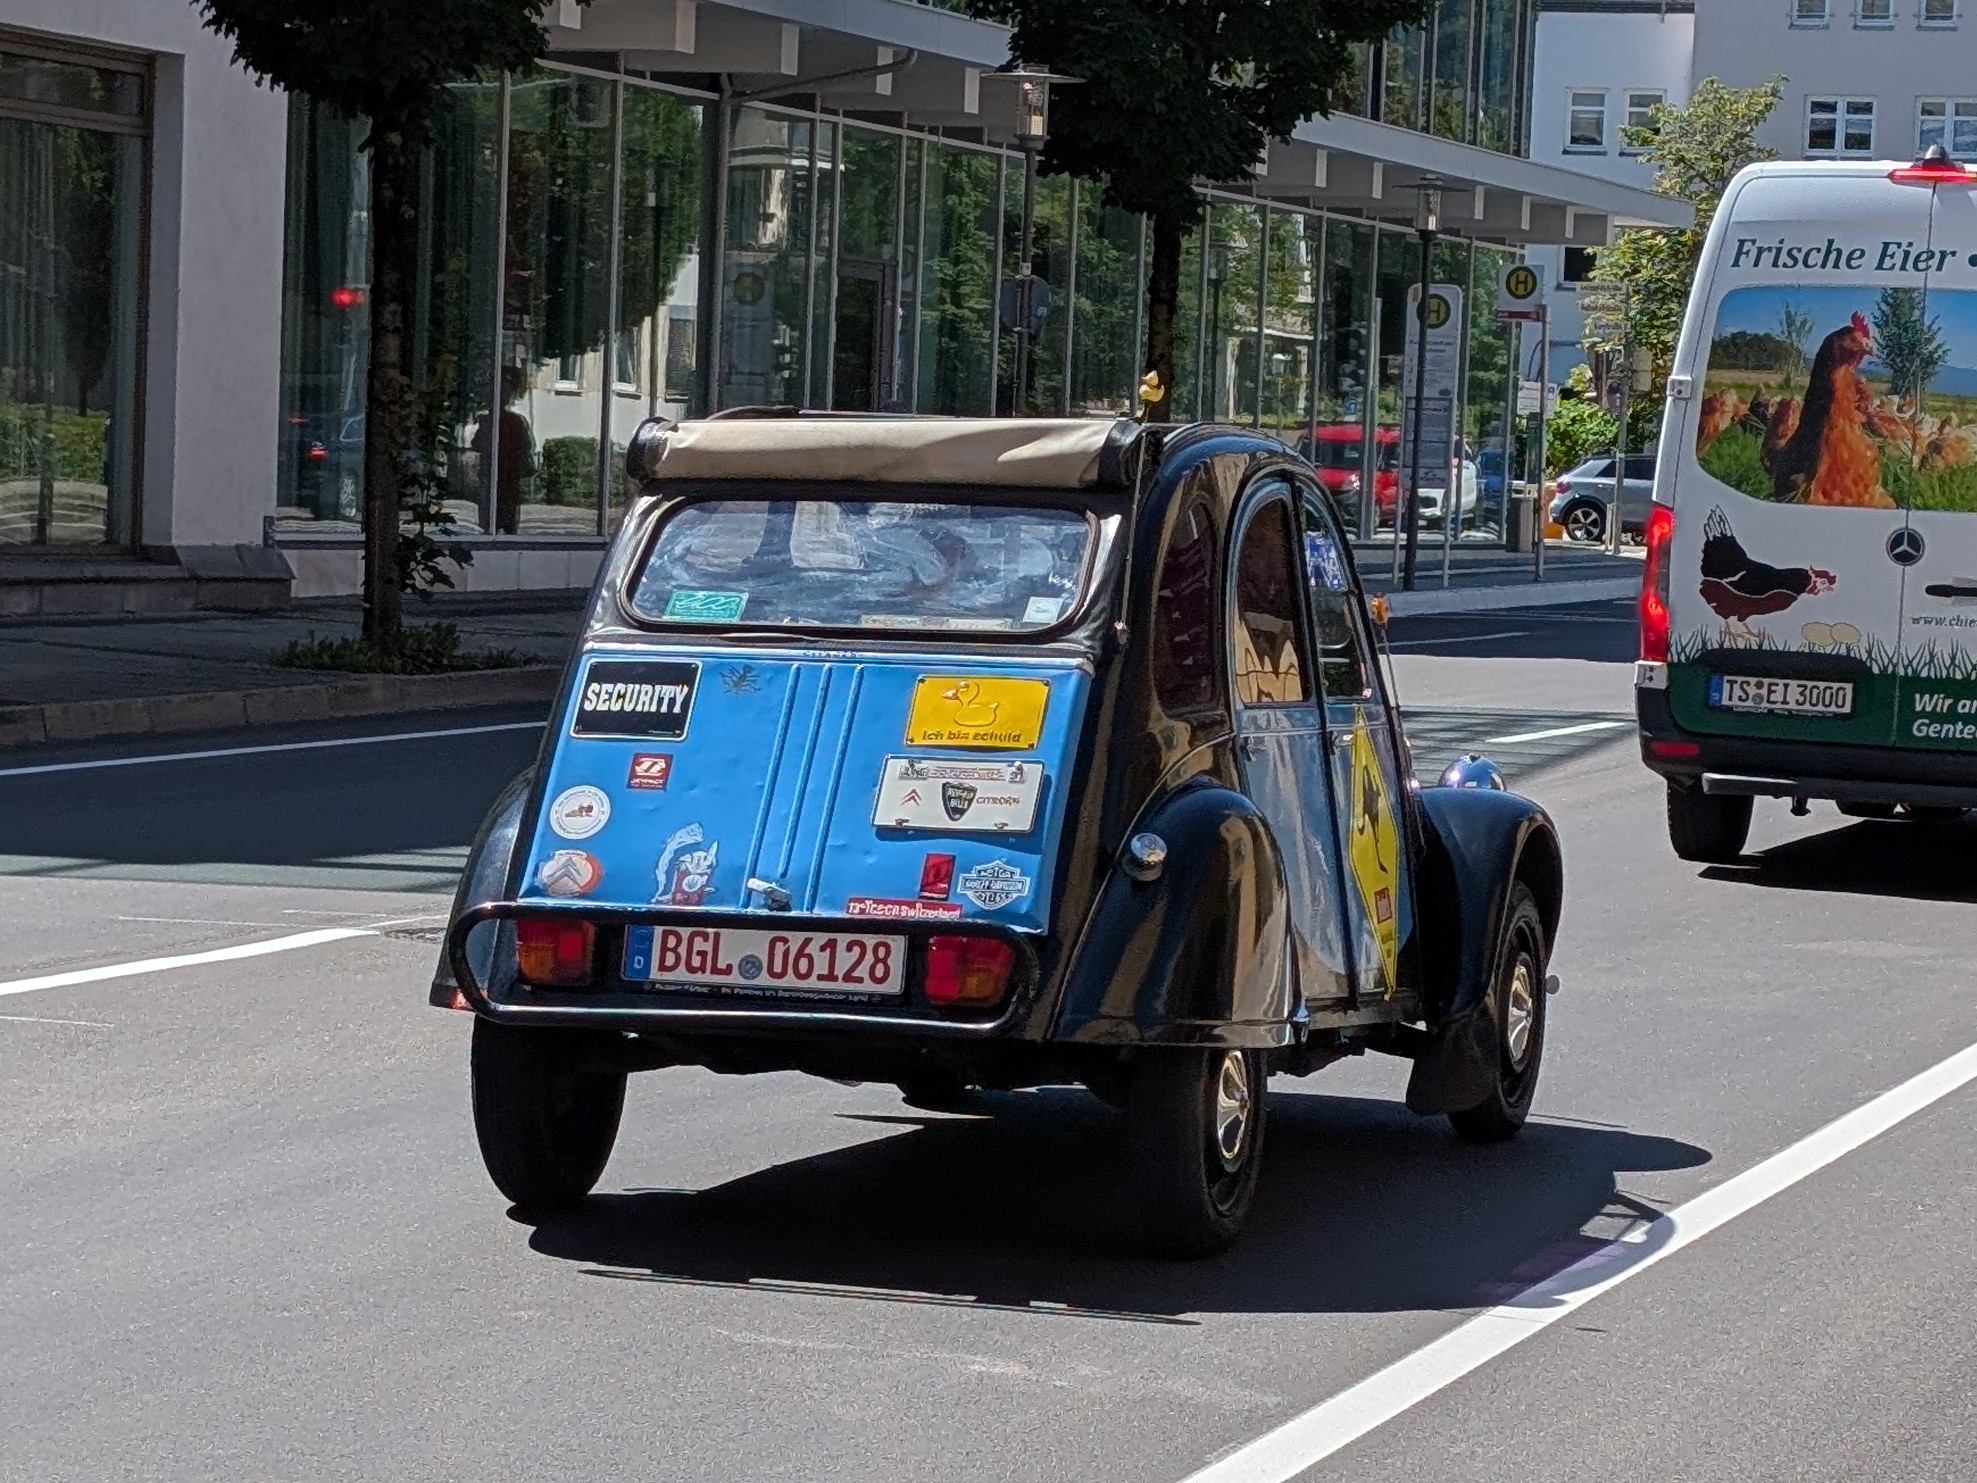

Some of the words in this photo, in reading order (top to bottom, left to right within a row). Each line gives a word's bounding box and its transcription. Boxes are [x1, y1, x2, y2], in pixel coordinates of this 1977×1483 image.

[1730, 238, 1866, 270] Frische
[1873, 241, 1958, 272] Eier
[1514, 273, 1529, 292] H
[583, 682, 690, 713] SECURITY
[1726, 679, 1751, 702] TS
[1766, 682, 1790, 705] EI
[1796, 684, 1847, 709] 3000
[1914, 693, 1954, 713] Wir
[1912, 718, 1977, 739] Gente
[634, 956, 644, 969] D
[657, 929, 733, 976] BGL
[766, 935, 892, 985] 06128
